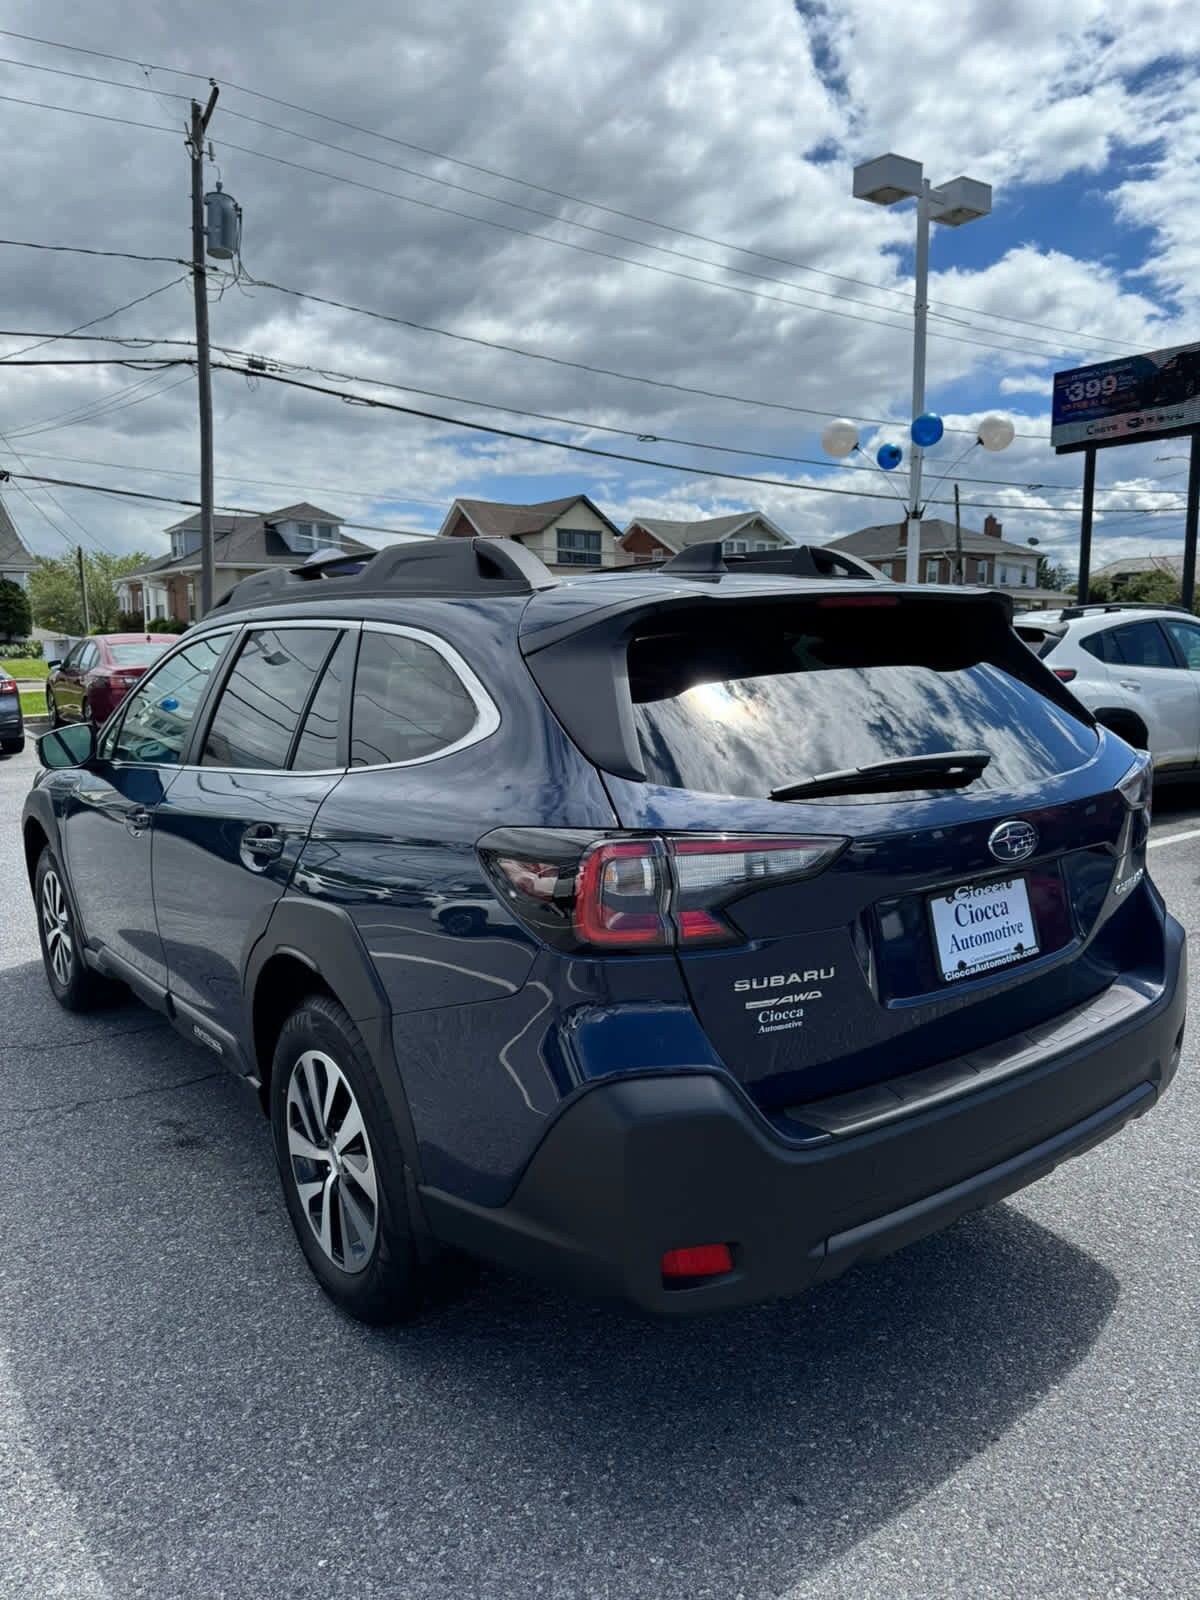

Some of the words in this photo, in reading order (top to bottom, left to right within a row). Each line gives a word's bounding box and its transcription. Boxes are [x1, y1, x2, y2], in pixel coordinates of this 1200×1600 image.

[954, 900, 1009, 927] Ciocca
[949, 920, 1024, 954] Automotive
[945, 946, 1040, 981] CioccaAutomotive.com
[734, 966, 835, 992] SUBARU
[776, 990, 822, 1005] AWD
[758, 1008, 804, 1023] Ciocca
[758, 1020, 803, 1034] Automotive
